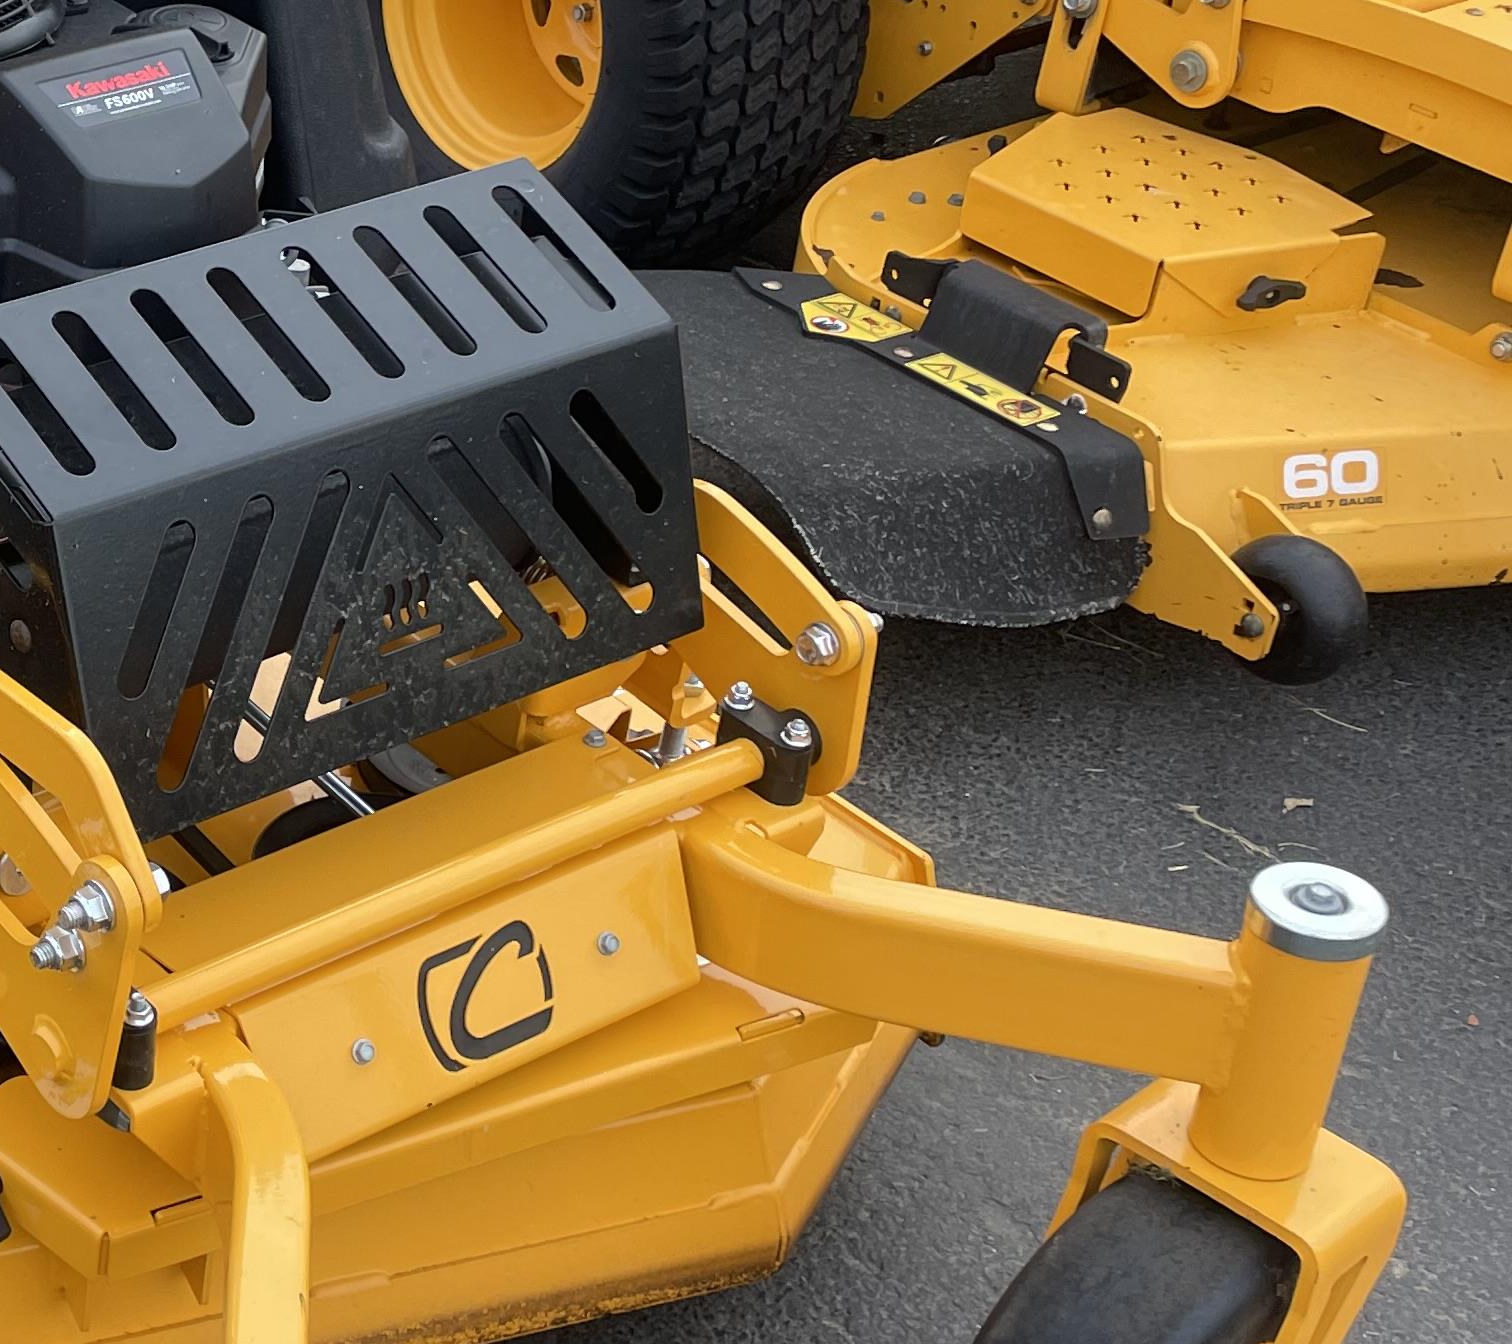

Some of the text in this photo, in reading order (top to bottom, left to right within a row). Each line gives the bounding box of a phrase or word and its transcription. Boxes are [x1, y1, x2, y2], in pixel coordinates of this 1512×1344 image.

[64, 60, 171, 100] Kawasaki
[103, 87, 155, 111] FS600V
[1283, 449, 1379, 499] 60
[1279, 496, 1383, 511] TRIPLE 7 GAUGE
